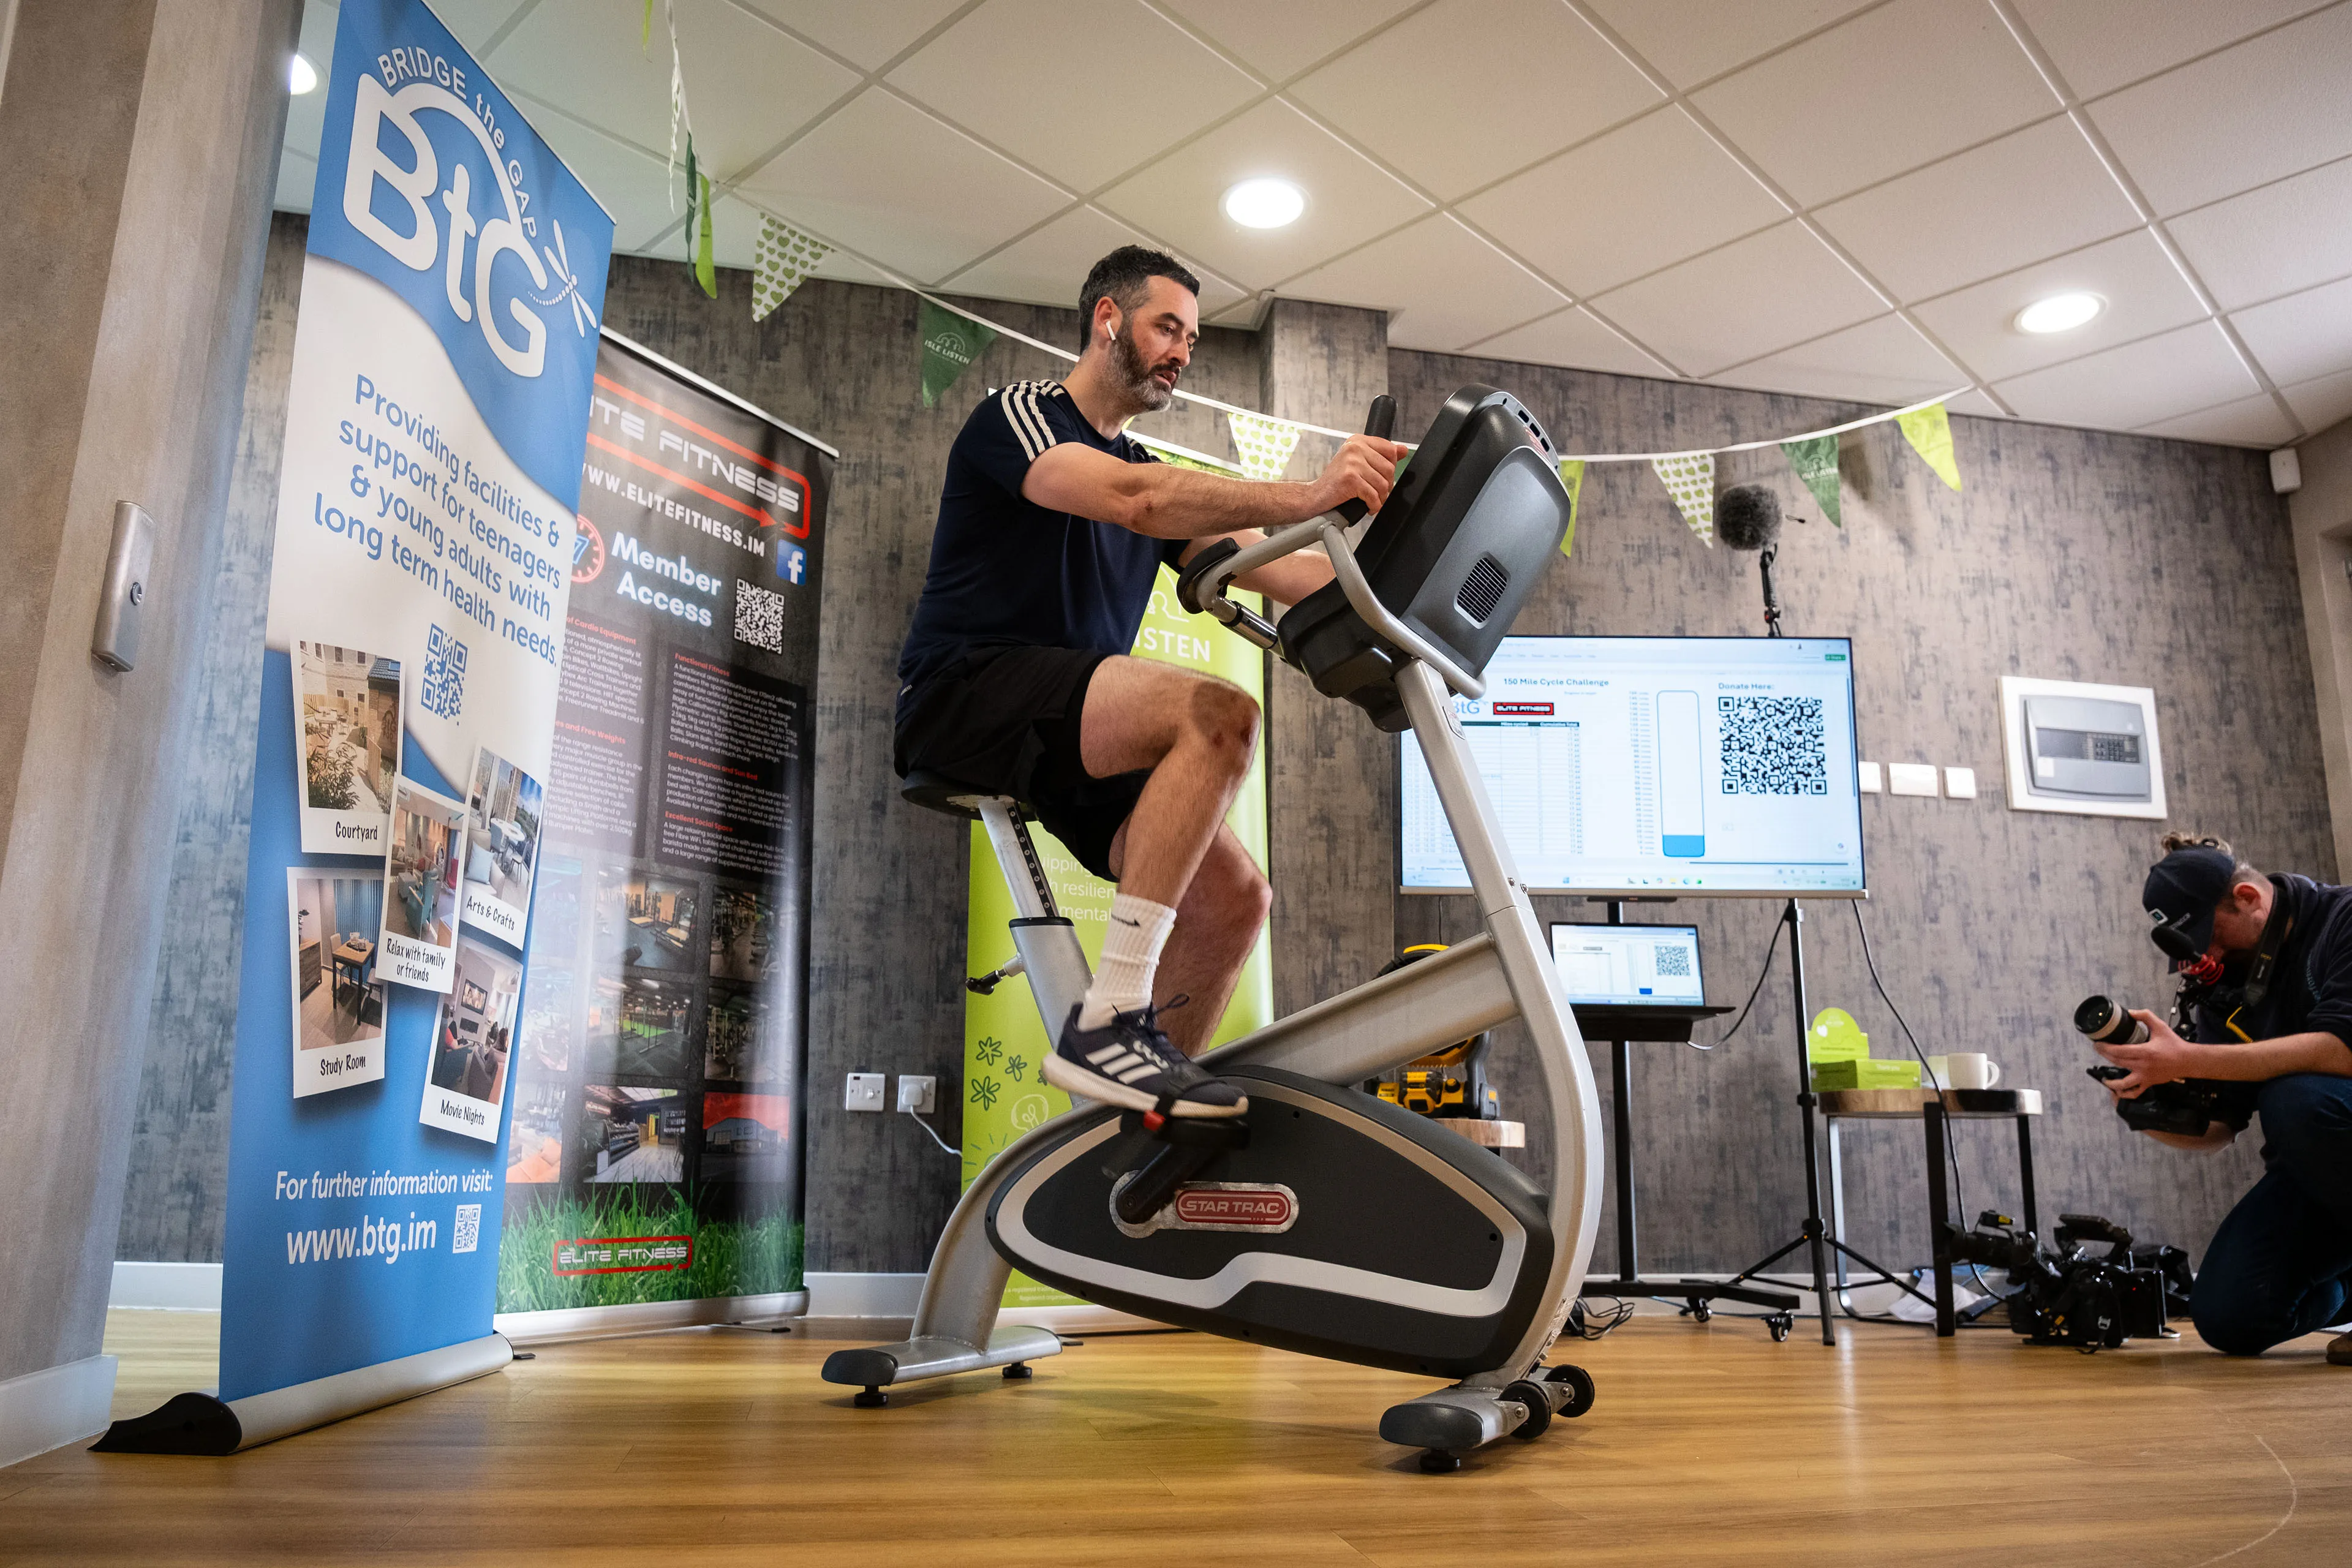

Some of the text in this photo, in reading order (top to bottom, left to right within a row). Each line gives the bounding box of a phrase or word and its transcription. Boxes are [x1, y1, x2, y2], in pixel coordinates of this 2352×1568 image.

[377, 46, 537, 238] BRIDGE the GAP
[343, 73, 548, 378] BtG
[924, 339, 941, 353] ISLE
[942, 348, 971, 364] LISTEN
[355, 374, 560, 548] Providing facilities &
[589, 394, 800, 513] ITE FITNESS
[339, 419, 561, 590] support for teenagers
[349, 464, 551, 622] & young adults with
[611, 531, 722, 597] Member
[314, 492, 558, 668] long term health needs.
[616, 570, 713, 628] Access
[565, 628, 586, 641] tioned,
[587, 635, 635, 657] atmospherically
[575, 619, 598, 632] Cardio
[599, 627, 636, 646] Equipment
[1134, 627, 1211, 663] ISTEN
[569, 646, 596, 661] Concept
[601, 657, 624, 671] Rowing
[579, 642, 597, 652] more
[597, 647, 618, 660] private
[619, 655, 642, 667] workout
[674, 652, 729, 677] Functional Fitness
[621, 671, 643, 685] Upright
[673, 670, 699, 684] members
[700, 679, 709, 688] the
[710, 682, 726, 694] space
[733, 690, 750, 703] spread
[679, 664, 706, 678] functional
[706, 674, 719, 683] area
[719, 678, 746, 693] measuring
[775, 696, 797, 709] allowing
[1504, 677, 1610, 687] 150 Mile Cycle Challenge
[673, 678, 706, 695] comfortable
[706, 689, 727, 701] artificial
[728, 697, 742, 707] grass
[742, 701, 753, 709] and
[753, 704, 767, 715] enjoy
[777, 710, 791, 722] large
[560, 736, 571, 744] the
[572, 739, 591, 751] range
[592, 744, 622, 758] resistance
[565, 722, 579, 732] and
[580, 725, 596, 736] Free
[597, 730, 626, 747] Weights
[669, 733, 694, 748] Climbing
[695, 741, 708, 752] Rope
[709, 745, 720, 754] and
[720, 748, 735, 758] much
[551, 759, 582, 773] advanced
[606, 772, 617, 782] The
[617, 775, 629, 785] free
[558, 752, 590, 766] controlled
[590, 761, 616, 773] exercise
[625, 769, 635, 778] the
[564, 745, 583, 757] major
[584, 750, 606, 762] muscle
[608, 756, 625, 769] group
[633, 763, 643, 772] the
[668, 750, 758, 781] Infra-red Saunas and Sun Bed
[667, 763, 681, 773] Each
[682, 767, 708, 782] changing
[709, 775, 723, 784] room
[723, 778, 733, 786] has
[741, 783, 764, 794] infra-red
[765, 790, 781, 798] sauna
[334, 821, 378, 841] Courtyard
[665, 810, 733, 834] Excellent Social Space
[1042, 853, 1092, 878] ippin
[1063, 882, 1117, 900] resilien
[466, 895, 516, 932] Arts & Crafts
[1059, 905, 1112, 922] mental
[386, 937, 447, 971] Relax with family
[397, 963, 430, 983] or friends
[320, 1054, 367, 1077] Study Room
[440, 1099, 485, 1126] Movie Nights
[275, 1169, 494, 1200] For further information visit:
[1185, 1200, 1280, 1215] STAR TRAC
[286, 1211, 437, 1265] www.btg.im
[559, 1246, 687, 1264] ELITE FITNESS
